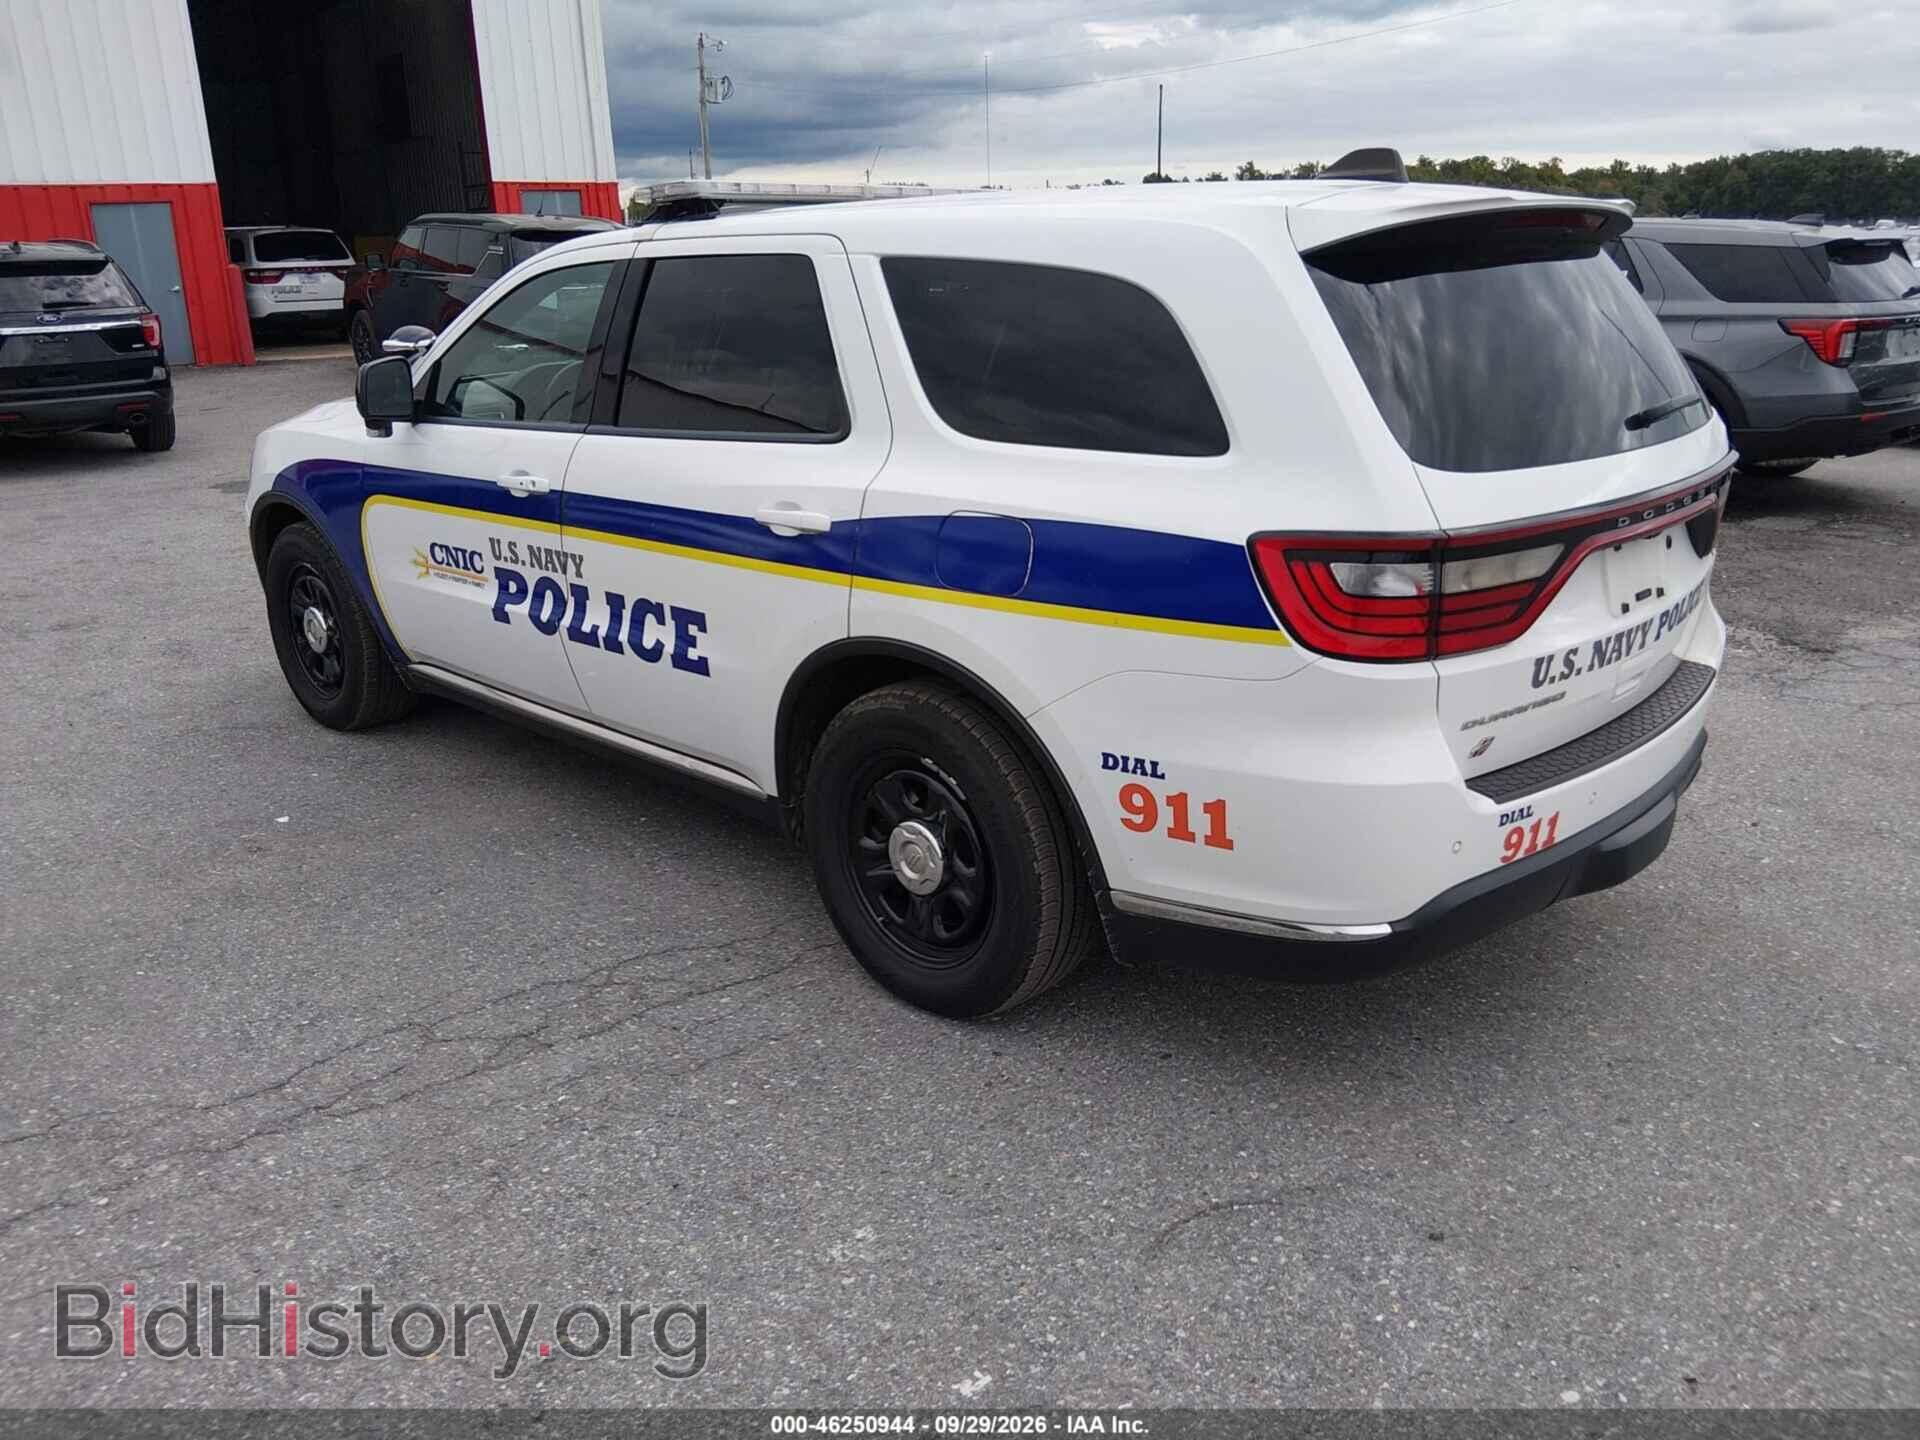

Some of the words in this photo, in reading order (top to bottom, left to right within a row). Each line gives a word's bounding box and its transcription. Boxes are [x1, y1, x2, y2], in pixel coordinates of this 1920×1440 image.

[429, 542, 484, 575] CNIC
[488, 537, 525, 566] U.S.
[526, 547, 584, 578] NAVY
[492, 566, 711, 677] POLICE
[1532, 648, 1582, 688] U.S.
[1587, 619, 1654, 671] NAVY
[1101, 752, 1166, 780] DIAL
[1119, 783, 1234, 851] 911
[1498, 805, 1534, 827] DIAL
[1500, 810, 1560, 863] 911
